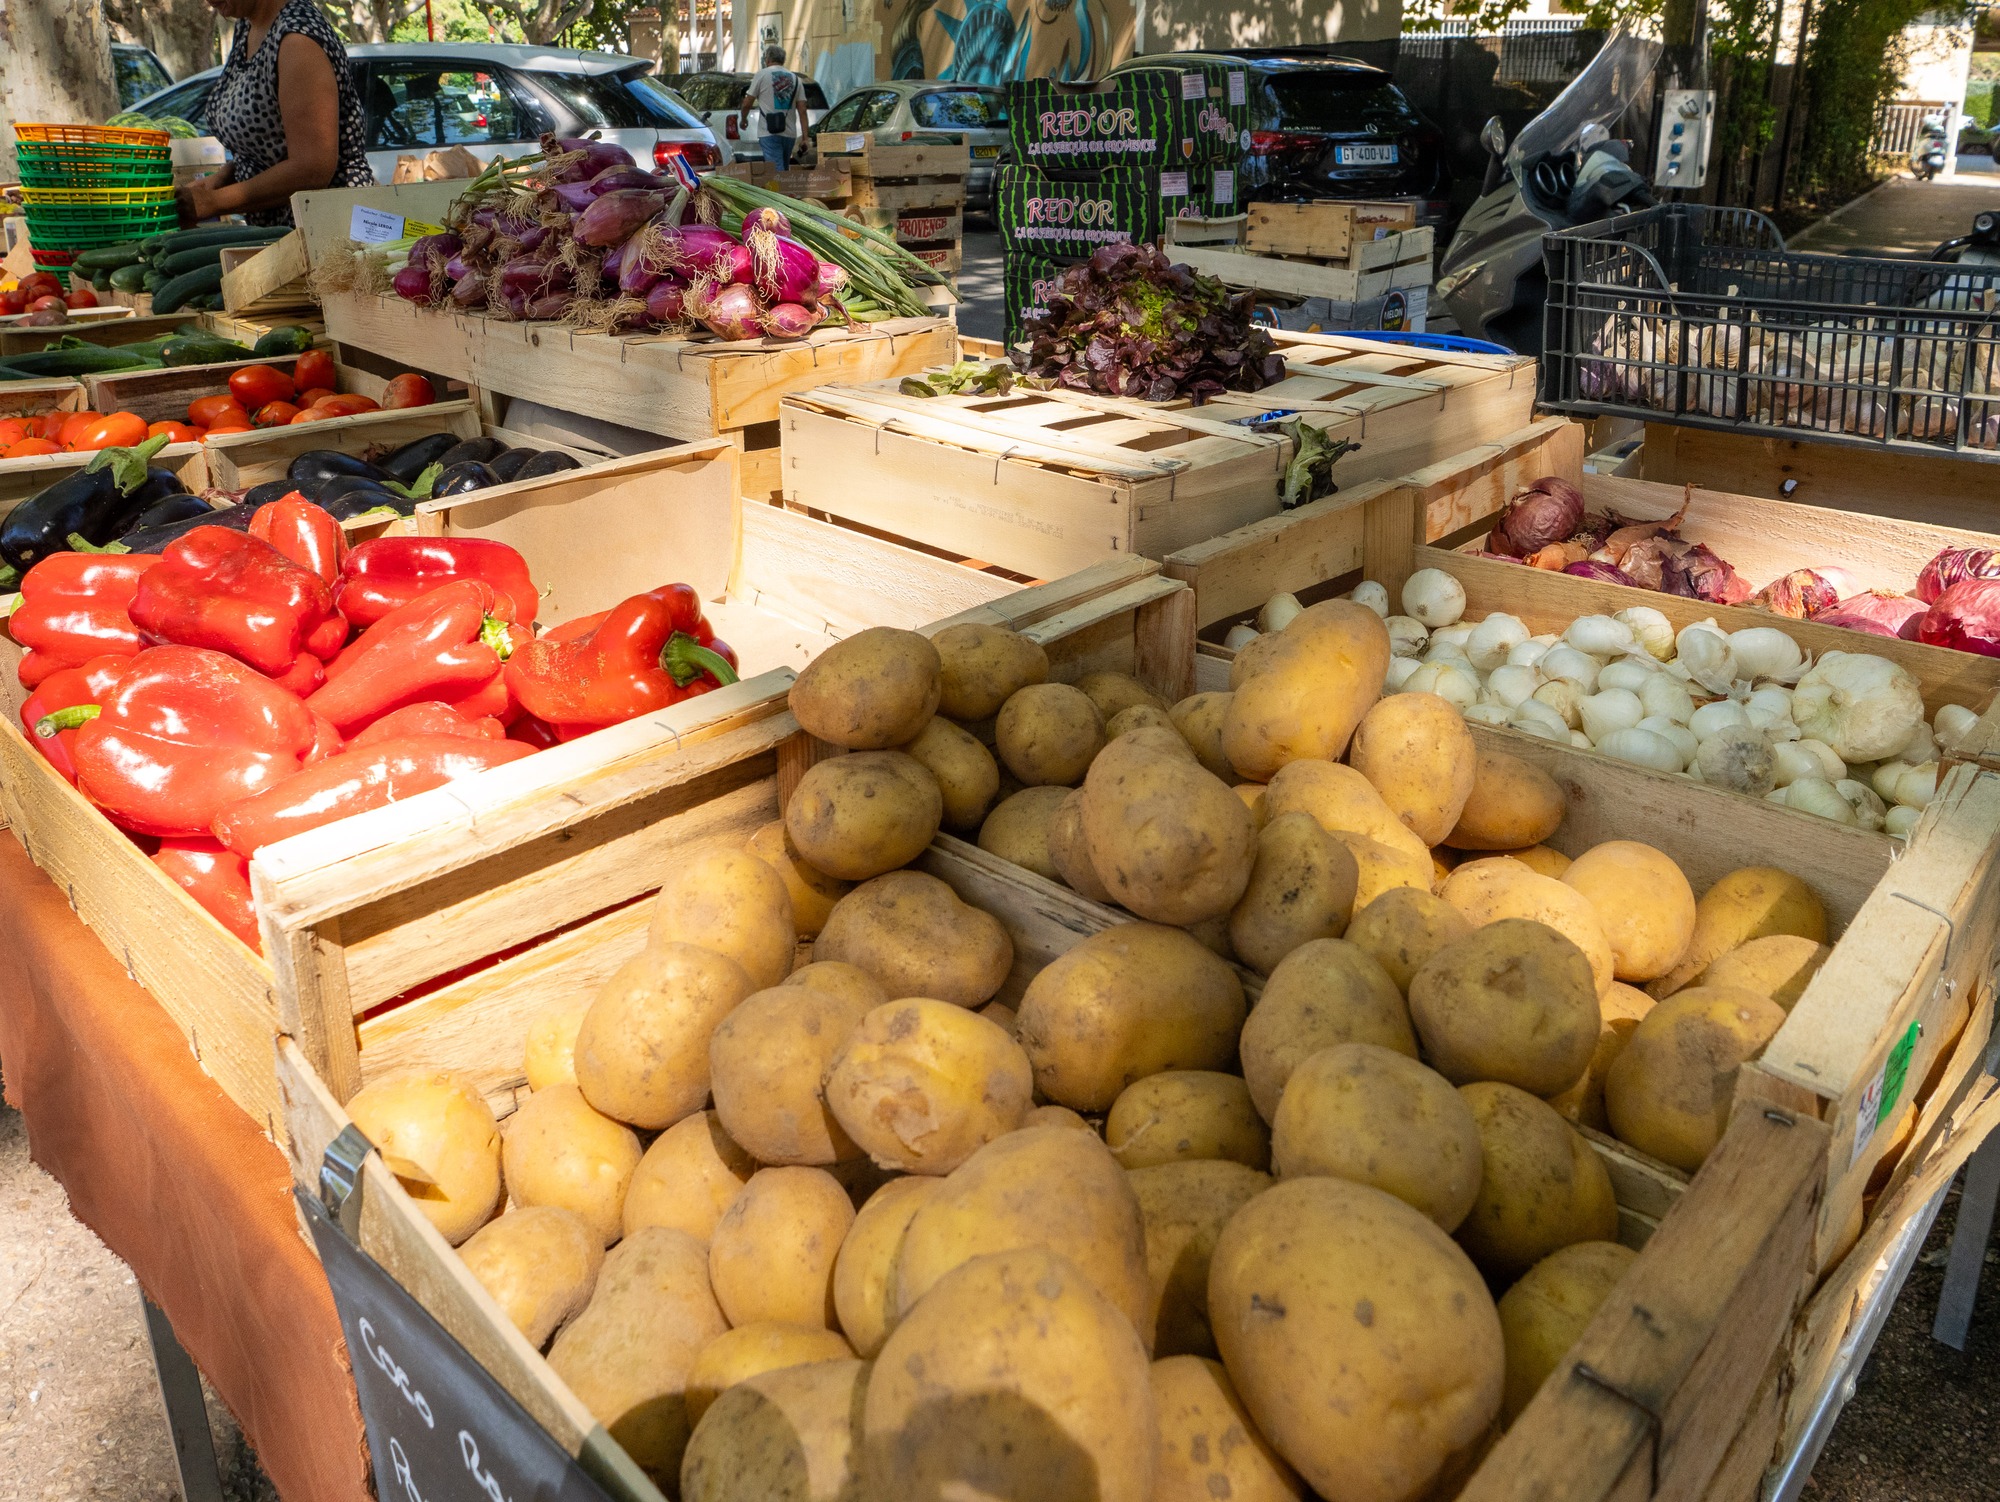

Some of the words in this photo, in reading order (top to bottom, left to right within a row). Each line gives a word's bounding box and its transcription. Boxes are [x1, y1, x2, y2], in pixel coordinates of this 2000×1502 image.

[1040, 107, 1137, 138] RED'OR
[1028, 142, 1041, 155] LA
[1089, 141, 1104, 153] DE
[1104, 138, 1156, 153] PROVENCE
[1027, 196, 1114, 226] RED'OR
[1071, 229, 1084, 240] DE
